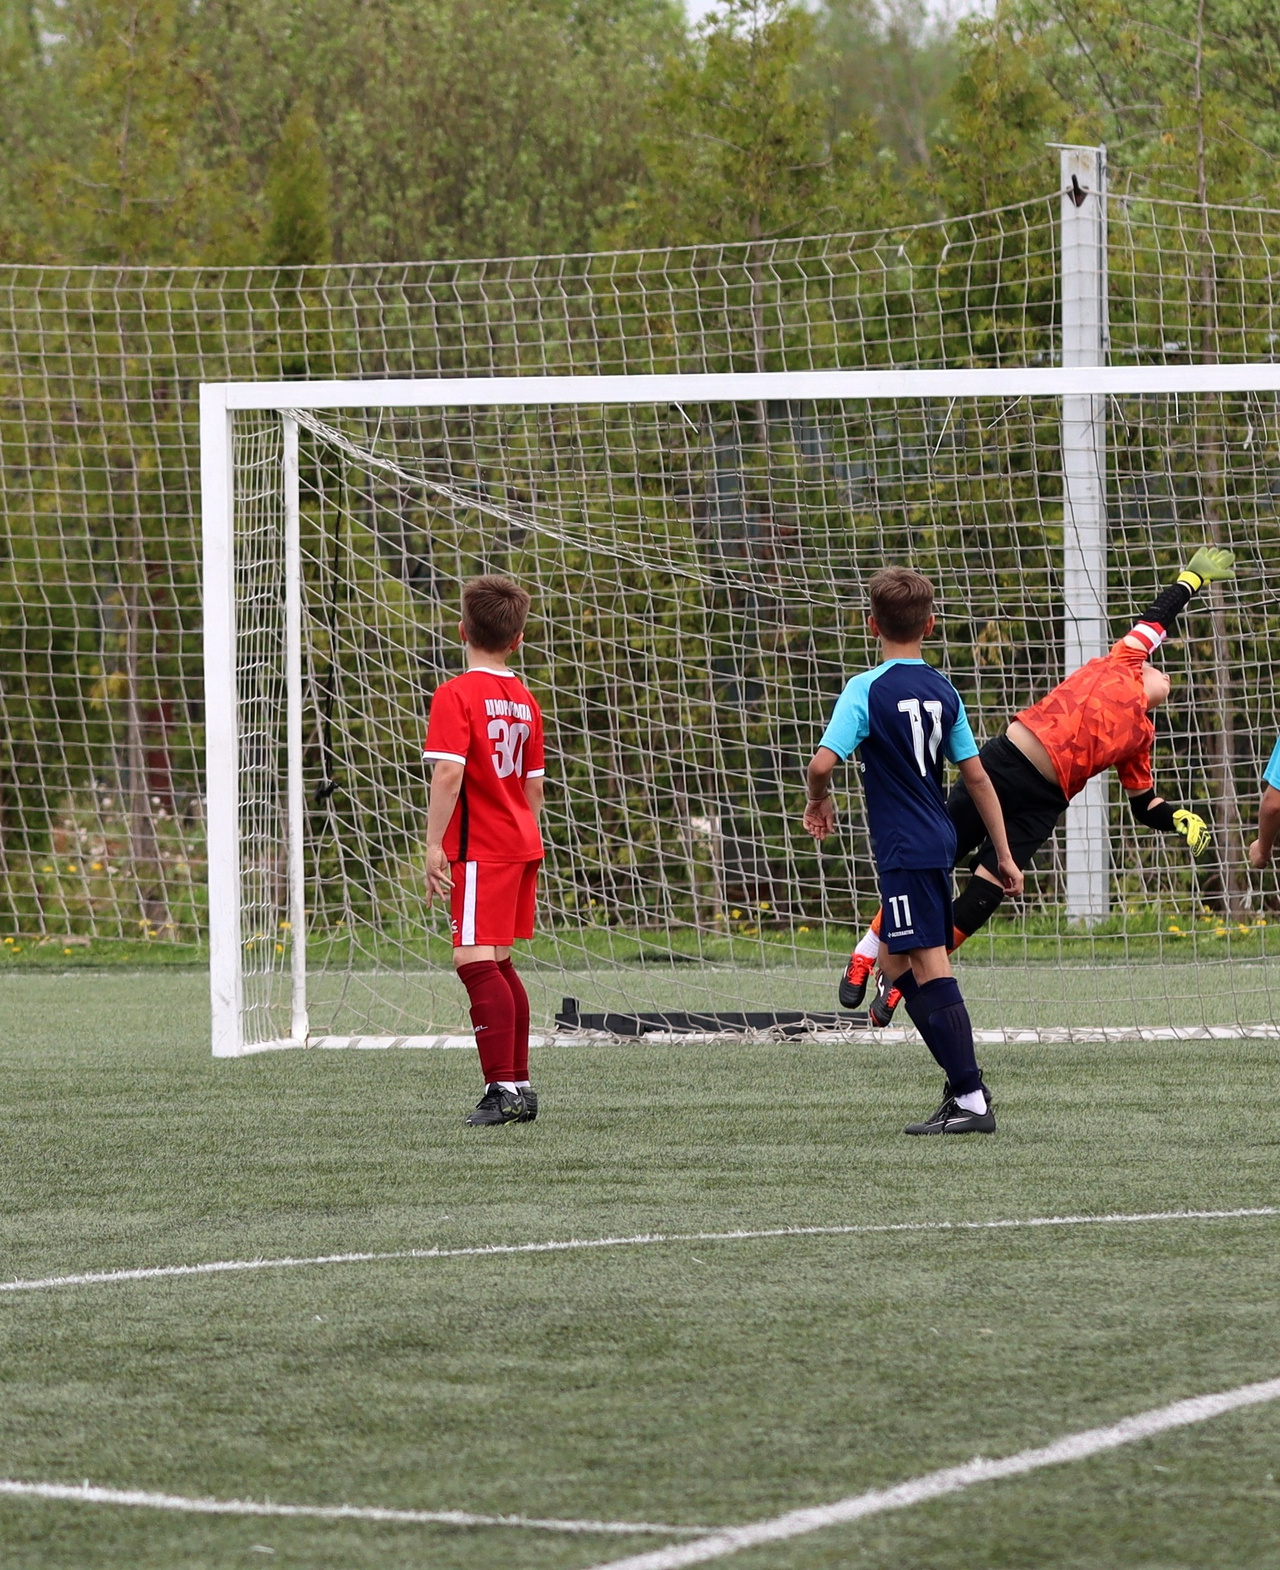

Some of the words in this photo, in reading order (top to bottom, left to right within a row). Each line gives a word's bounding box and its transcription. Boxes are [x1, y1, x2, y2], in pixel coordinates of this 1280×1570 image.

[487, 718, 530, 778] 30
[897, 698, 943, 777] 11
[888, 894, 912, 928] 11
